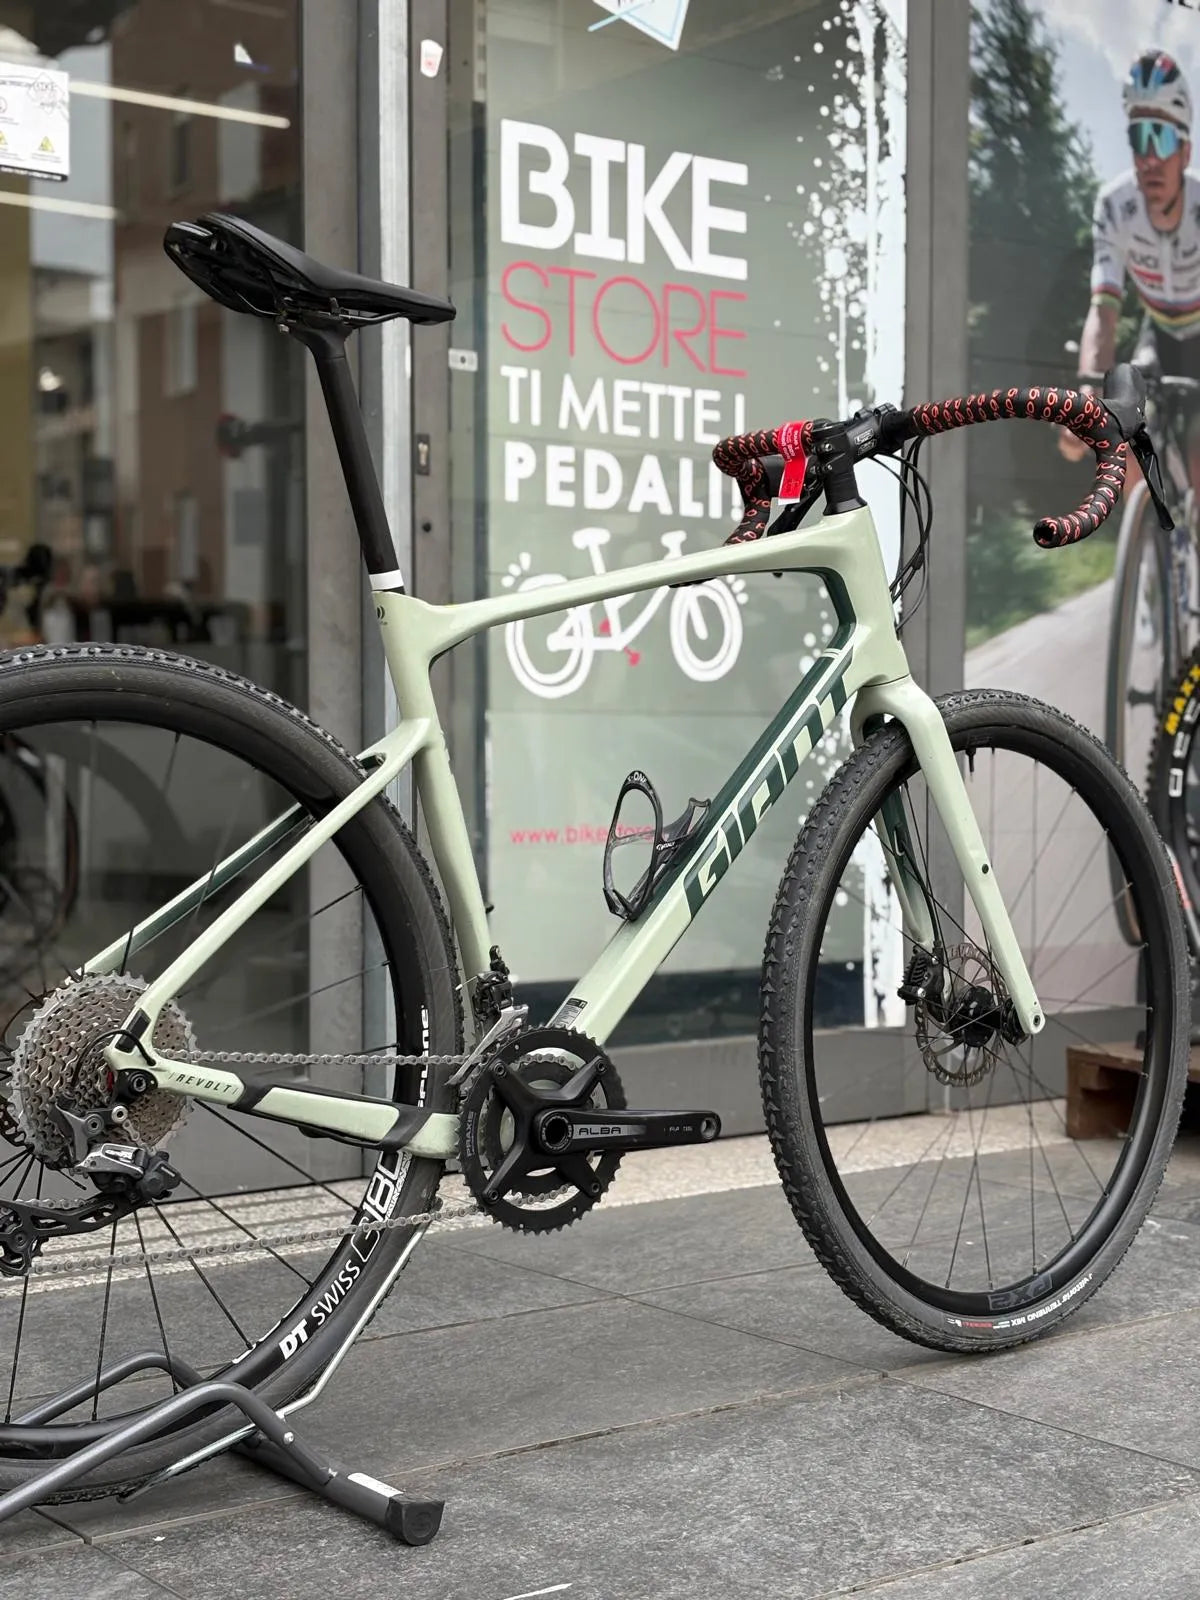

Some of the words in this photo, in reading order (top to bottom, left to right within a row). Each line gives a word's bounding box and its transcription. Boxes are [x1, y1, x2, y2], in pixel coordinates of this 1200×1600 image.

[501, 118, 748, 281] BIKE
[501, 260, 748, 379] STORE
[500, 365, 541, 427] TI
[558, 373, 722, 446] METTE
[504, 440, 743, 522] PEDALI!
[175, 1073, 233, 1093] REVOLT
[578, 1127, 622, 1136] ALBA
[278, 1318, 308, 1360] DT
[310, 1259, 361, 1326] SWISS
